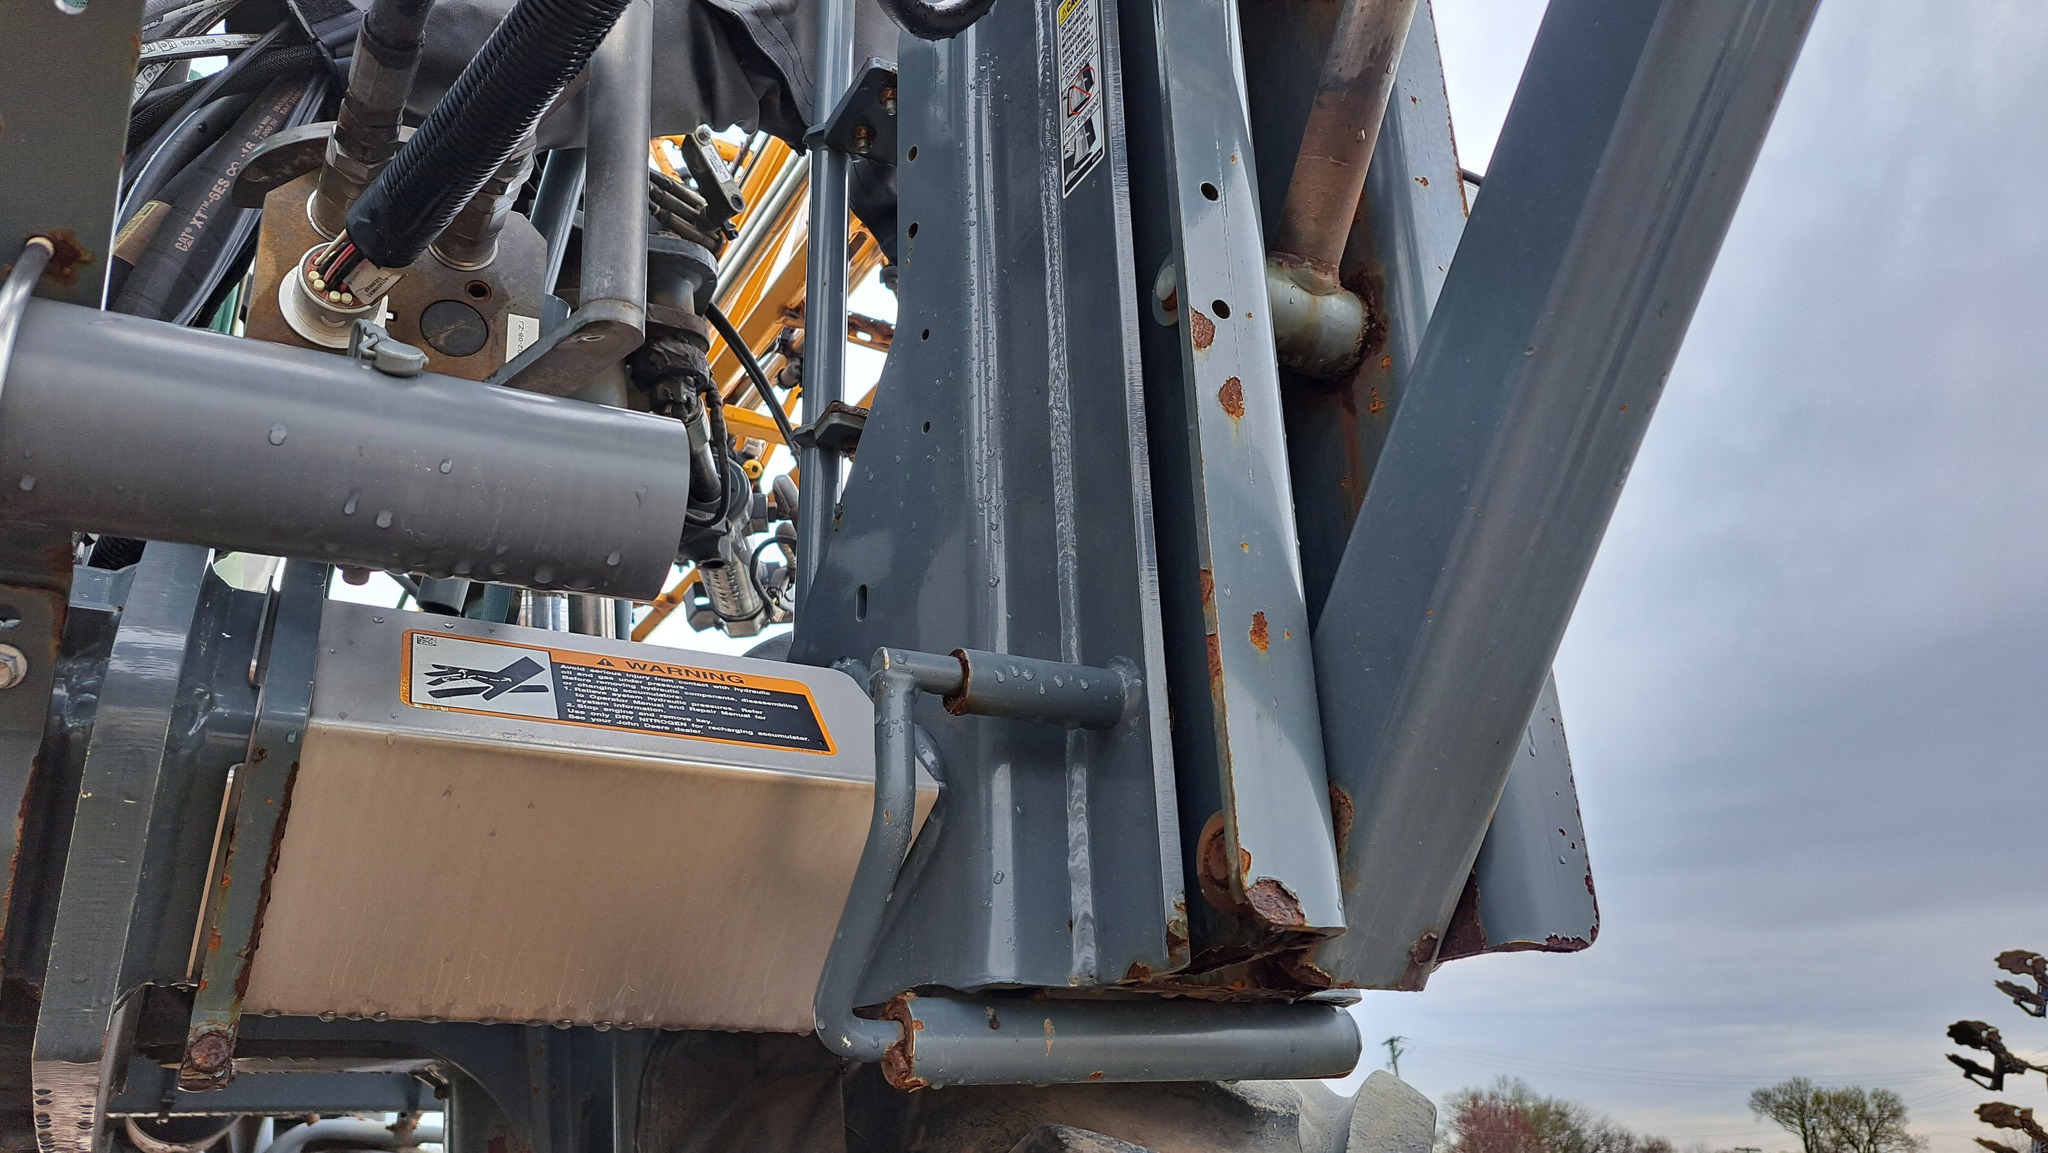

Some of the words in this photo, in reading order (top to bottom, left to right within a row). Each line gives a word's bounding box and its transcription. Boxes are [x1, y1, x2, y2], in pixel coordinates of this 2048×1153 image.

[1061, 3, 1088, 41] ATTACHMENTS
[1067, 10, 1075, 26] NOT
[1061, 23, 1079, 50] WITHOUT
[1079, 11, 1089, 28] FULL
[1062, 22, 1087, 58] ENGAGEMENT
[1062, 47, 1074, 66] QUICK
[1075, 28, 1089, 51] ATTACH
[1062, 58, 1072, 75] LOCK
[1074, 33, 1093, 62] ASSEMBLY
[1066, 45, 1093, 84] Disengaged
[1064, 121, 1075, 142] Fully
[1077, 95, 1098, 127] Engaged
[367, 277, 389, 298] ATTACHMENT
[625, 661, 744, 684] WARNING
[577, 682, 618, 692] changing
[595, 679, 636, 689] removing
[640, 685, 679, 694] hydraulic
[740, 698, 798, 709] disassembling
[647, 681, 687, 689] pressure.
[677, 679, 708, 687] contact
[733, 686, 771, 696] hydraulic
[576, 698, 609, 706] system
[613, 702, 666, 713] information.
[589, 694, 628, 703] Operator
[632, 699, 663, 707] Manual
[688, 706, 717, 714] Repair
[603, 707, 633, 715] engine
[611, 691, 642, 699] system
[647, 696, 686, 705] hydraulic
[690, 702, 735, 711] pressures.
[590, 716, 612, 724] your
[673, 726, 703, 734] dealer.
[638, 716, 687, 727] NITROGEN
[708, 725, 753, 735] recharging
[756, 731, 809, 741] accumulator.
